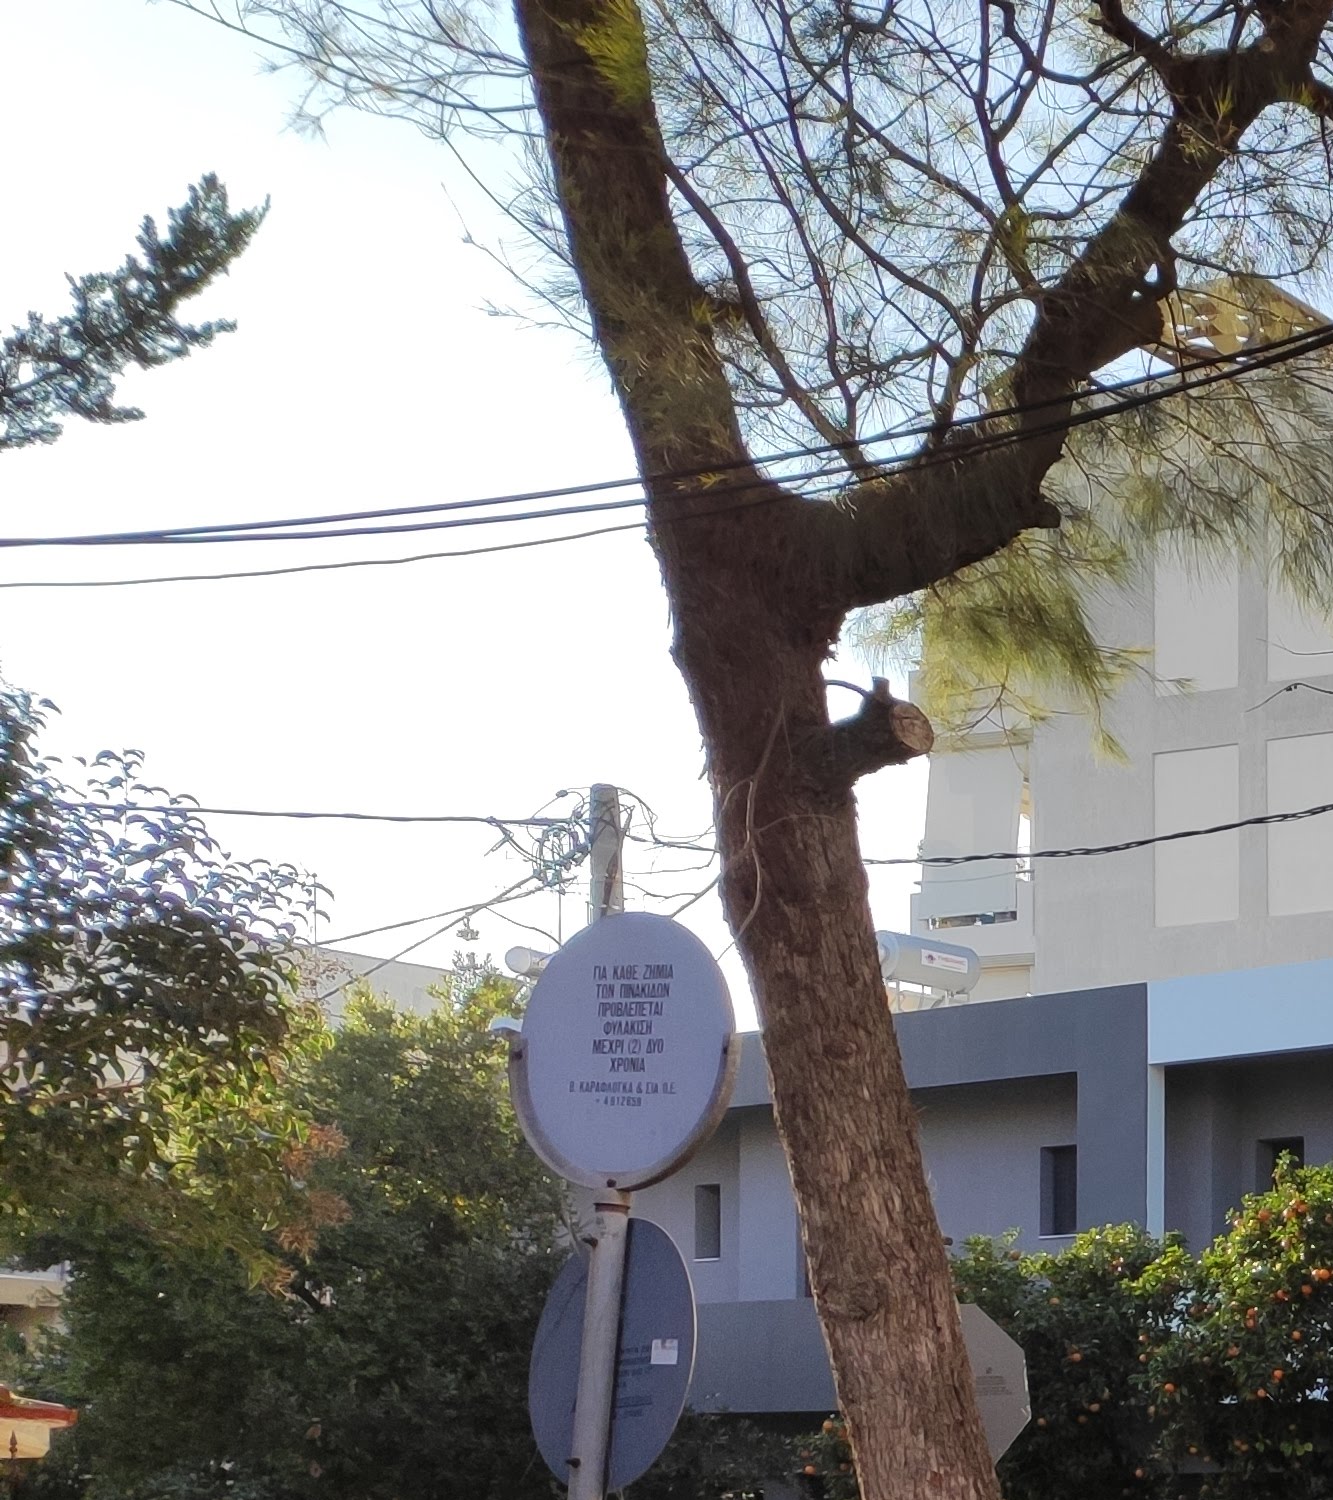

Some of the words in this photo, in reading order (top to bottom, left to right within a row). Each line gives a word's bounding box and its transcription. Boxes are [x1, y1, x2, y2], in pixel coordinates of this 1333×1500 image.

[593, 965, 607, 980] ΓΙΑ
[612, 964, 639, 980] ΚΑΘΕ
[643, 964, 674, 980] ΖΗΜΙΑ
[596, 983, 615, 998] ΤΩΝ
[619, 983, 670, 998] ΠΙΝΑΚΙΔΩΝ
[598, 1001, 664, 1017] ΠΡΟΒΛΕΠΕΤΑΙ
[603, 1019, 653, 1035] ΦΥΛΑΚΙΣΗ
[592, 1039, 625, 1054] ΜΕΧΡΙ
[627, 1039, 642, 1054] (2)
[645, 1038, 665, 1054] ΔΥΟ
[609, 1057, 646, 1072] ΧΡΟΝΙΑ
